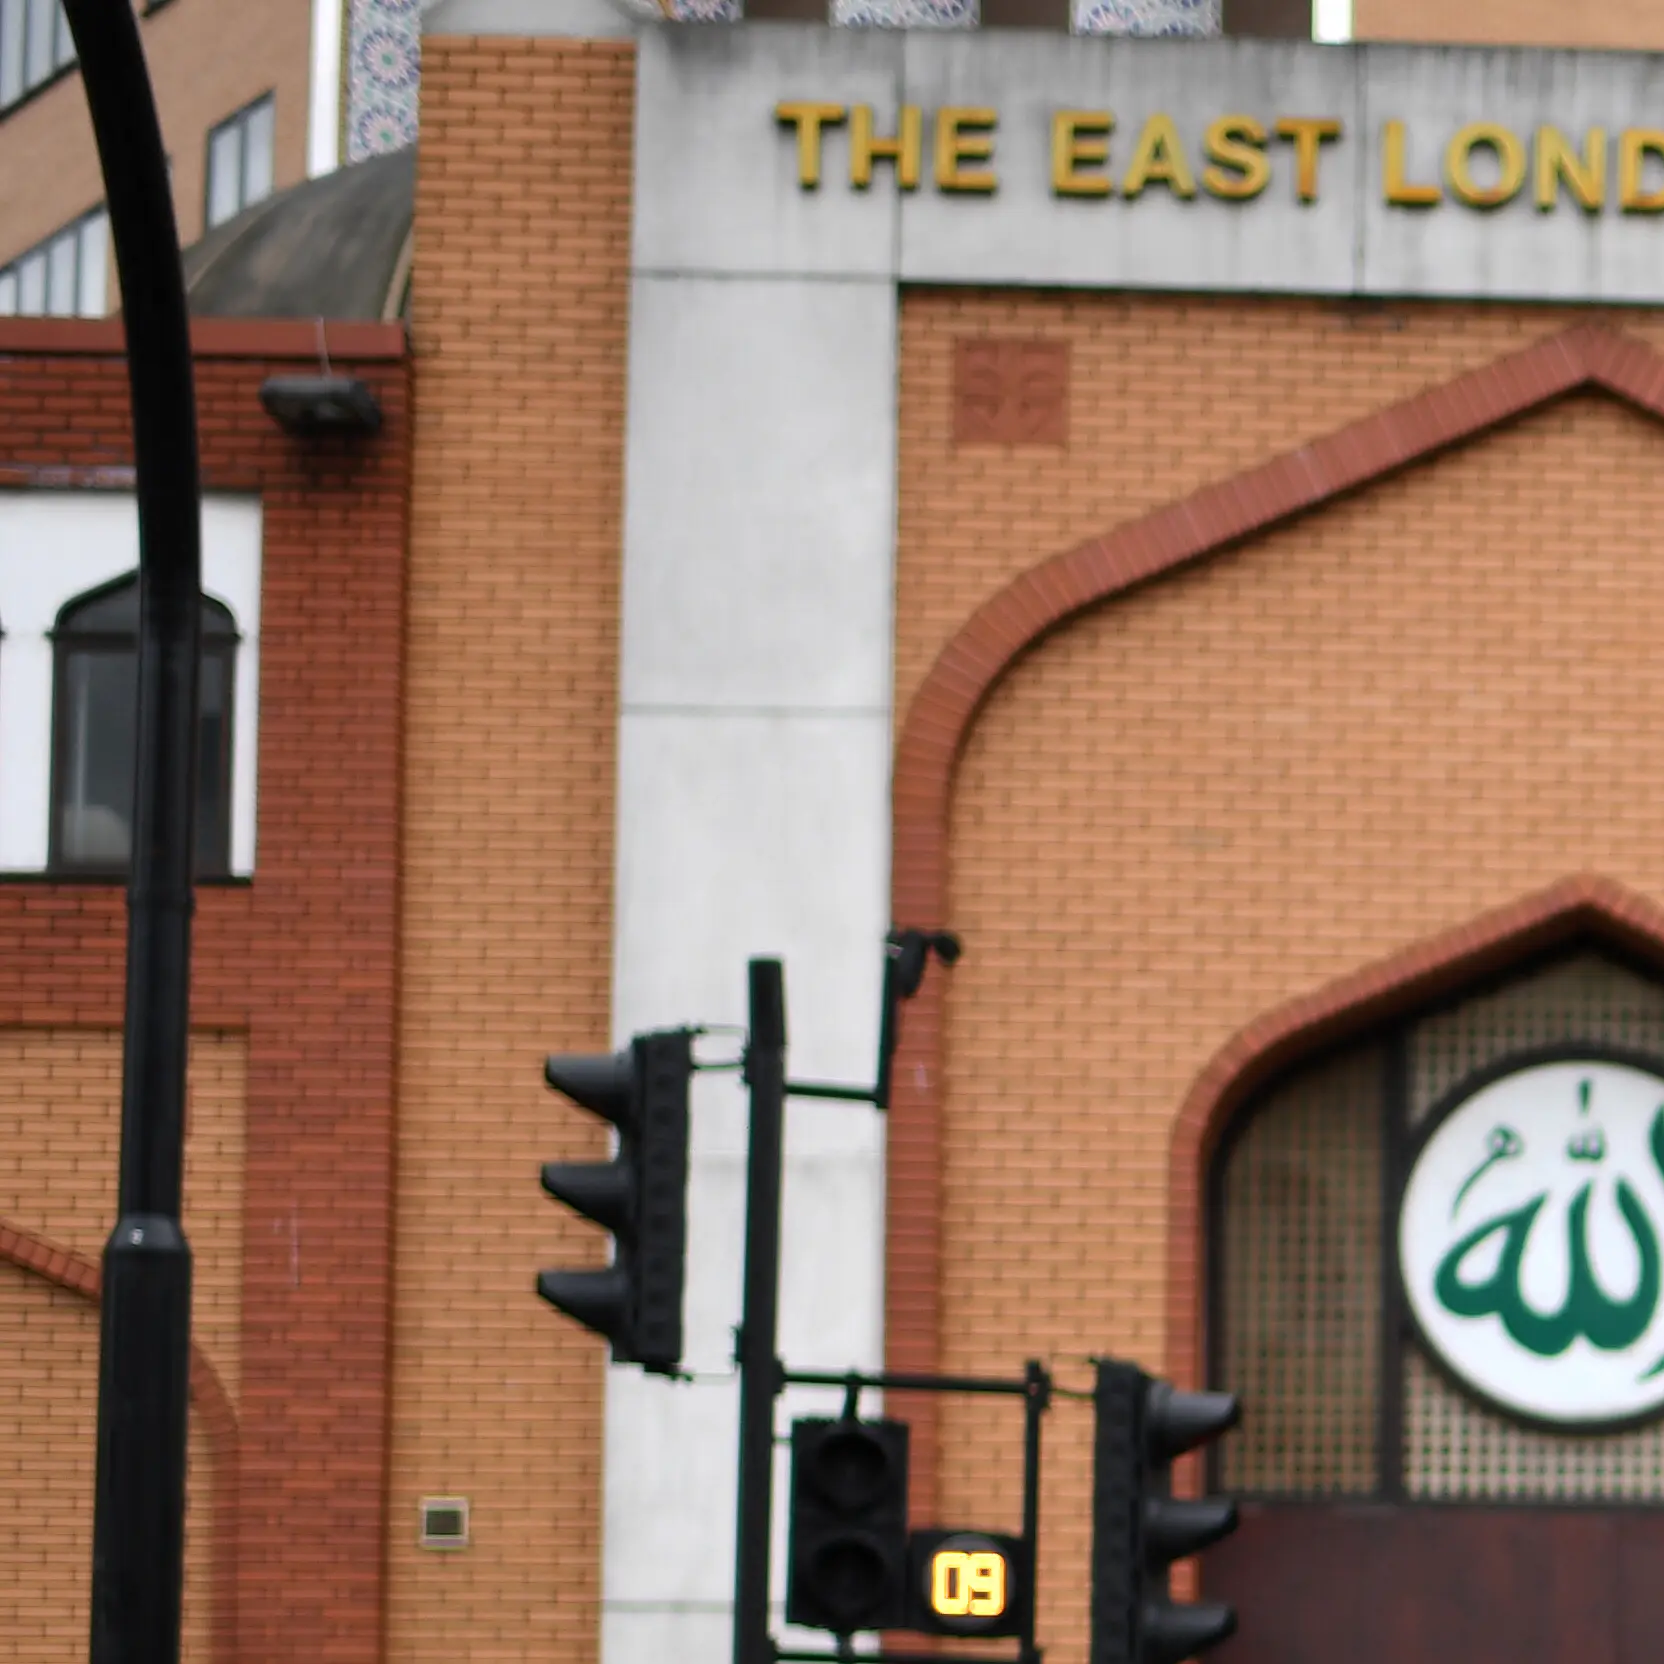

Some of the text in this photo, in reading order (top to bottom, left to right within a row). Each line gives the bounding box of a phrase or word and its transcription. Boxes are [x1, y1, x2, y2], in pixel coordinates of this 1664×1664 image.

[776, 102, 997, 192] THE
[1052, 111, 1342, 204] EAST
[932, 1551, 1004, 1616] 09
